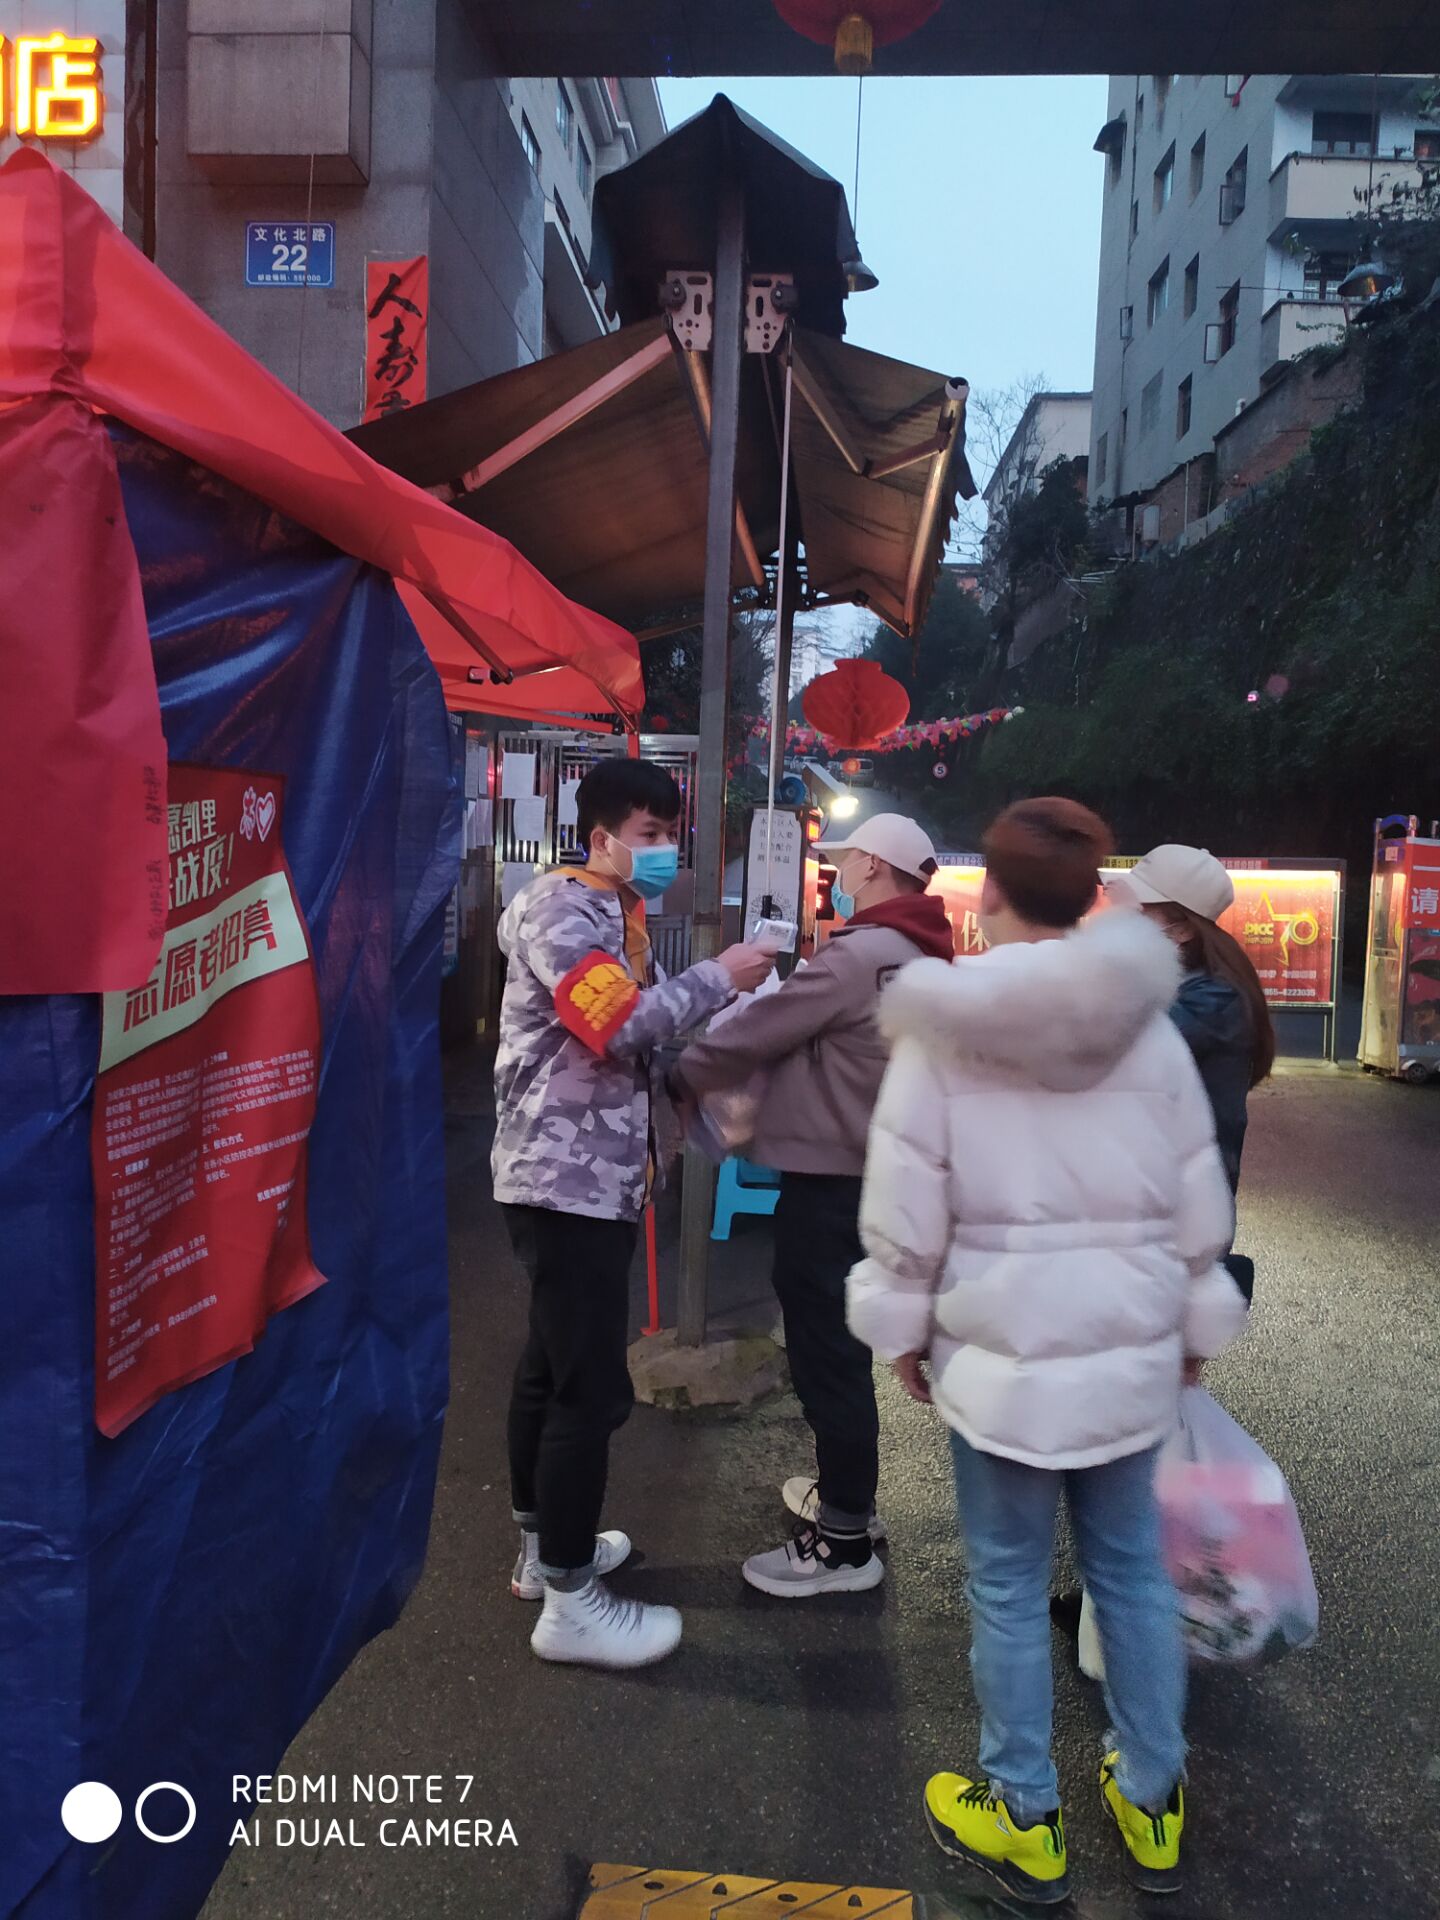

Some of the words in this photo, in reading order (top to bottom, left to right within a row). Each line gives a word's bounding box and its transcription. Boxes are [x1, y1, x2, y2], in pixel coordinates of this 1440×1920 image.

[0, 31, 97, 136] 店
[254, 227, 326, 242] 文化北路
[272, 244, 307, 271] 22
[168, 831, 235, 912] 战疫!
[1411, 888, 1439, 914] 请
